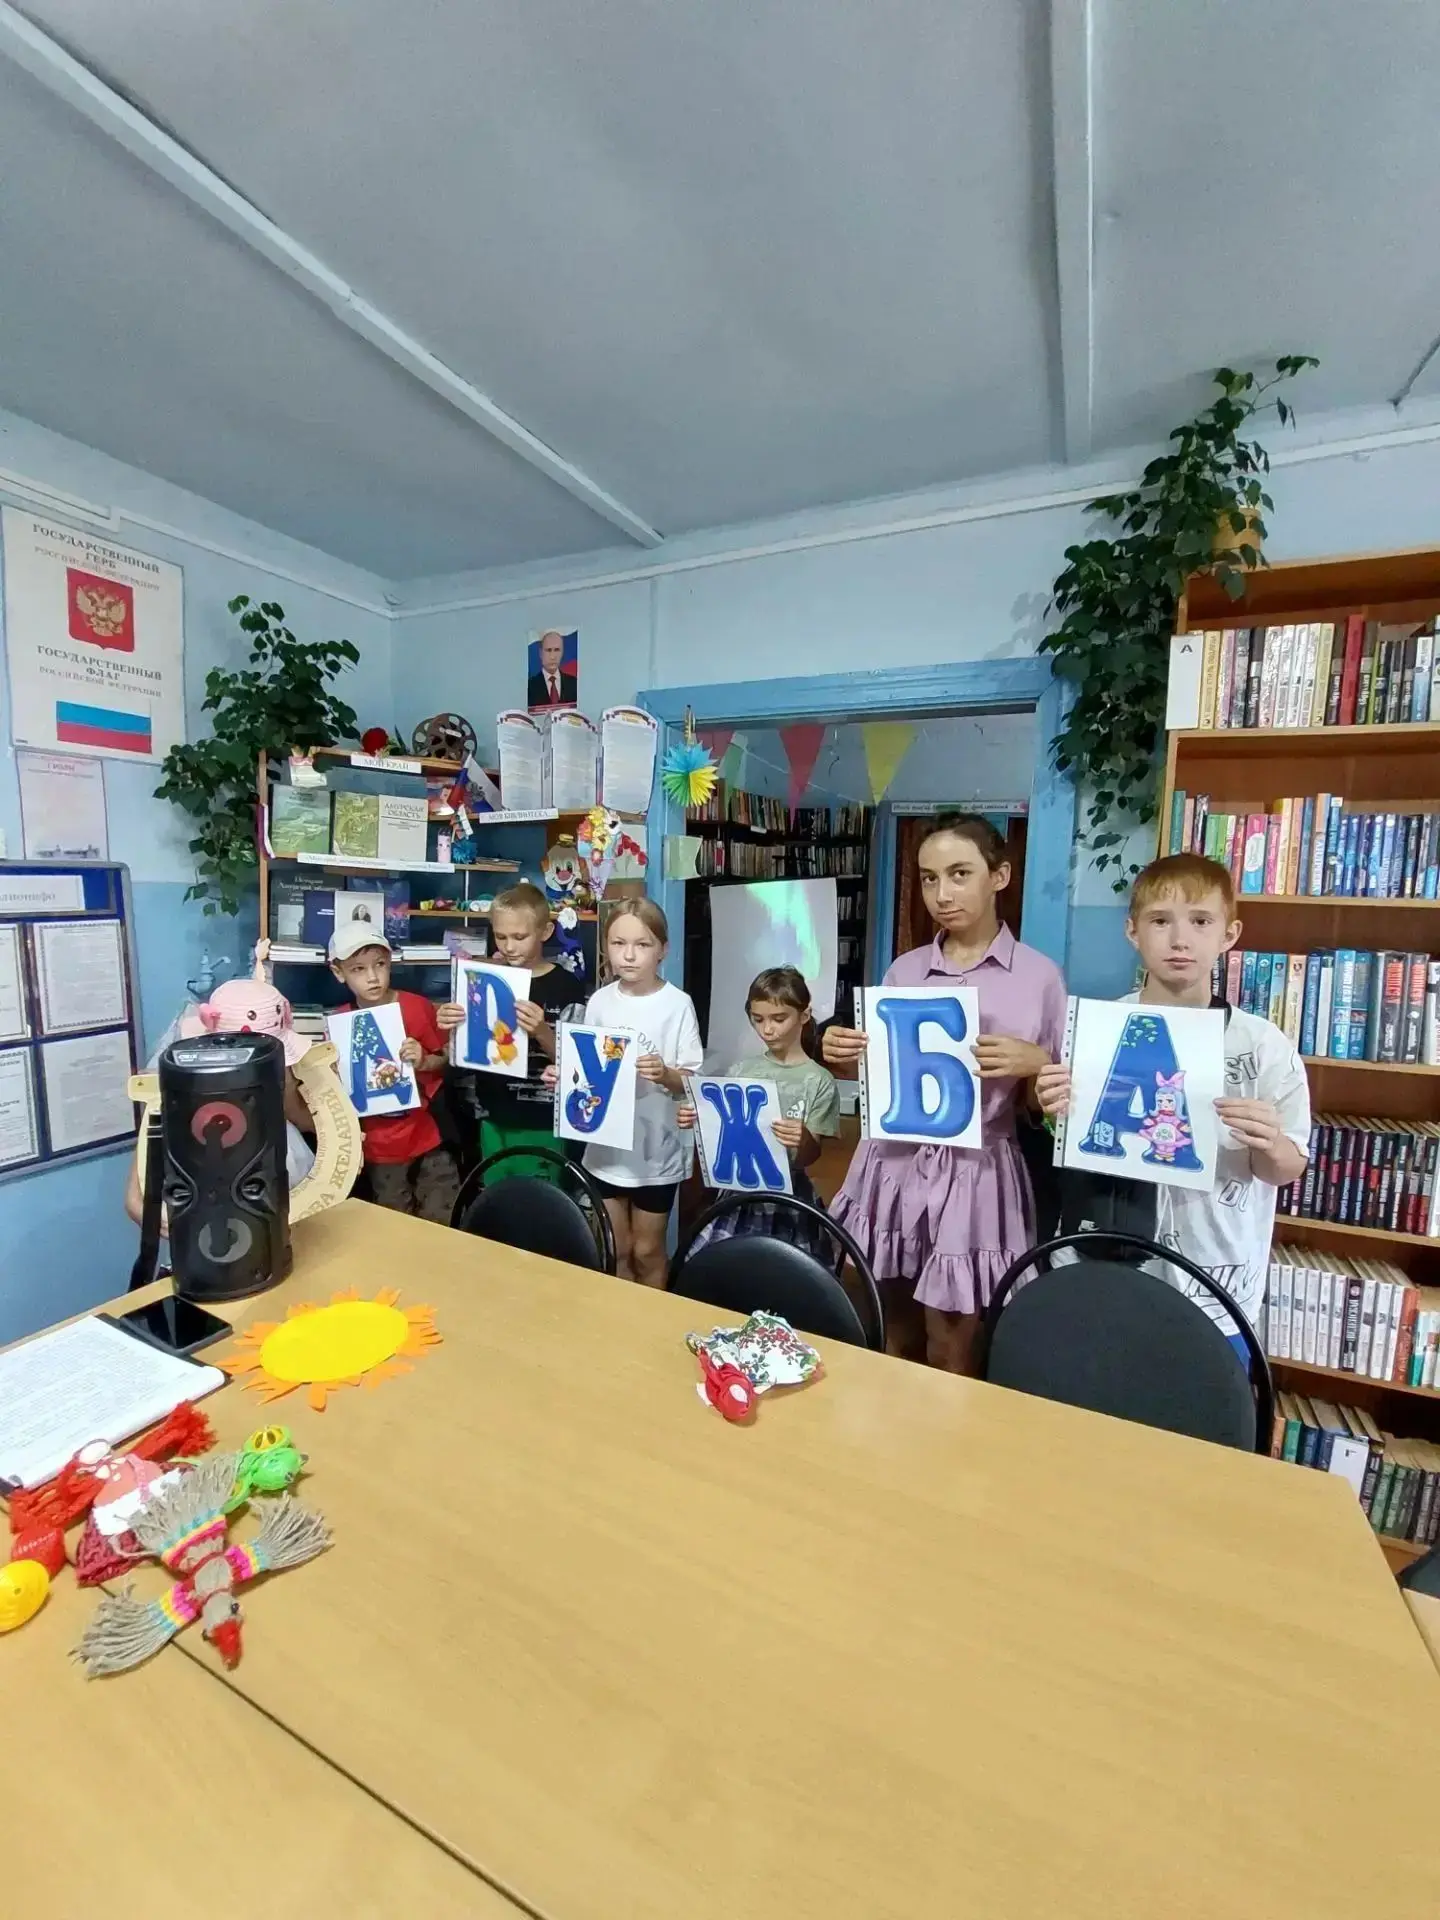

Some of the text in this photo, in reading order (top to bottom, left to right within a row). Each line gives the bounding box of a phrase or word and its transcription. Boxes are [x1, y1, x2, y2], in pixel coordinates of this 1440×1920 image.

[33, 523, 160, 574] ГОСУДАРСТВЕННЫЙ
[86, 552, 117, 569] ГЕРБ
[37, 645, 162, 681] ГОСУДАРСТВЕННЫЙ
[86, 667, 121, 681] ФЛАГ
[1180, 644, 1193, 653] А
[464, 967, 519, 1065] Р
[565, 1028, 632, 1134] У
[876, 997, 976, 1138] Б
[1078, 1011, 1205, 1173] А
[701, 1082, 785, 1190] Ж
